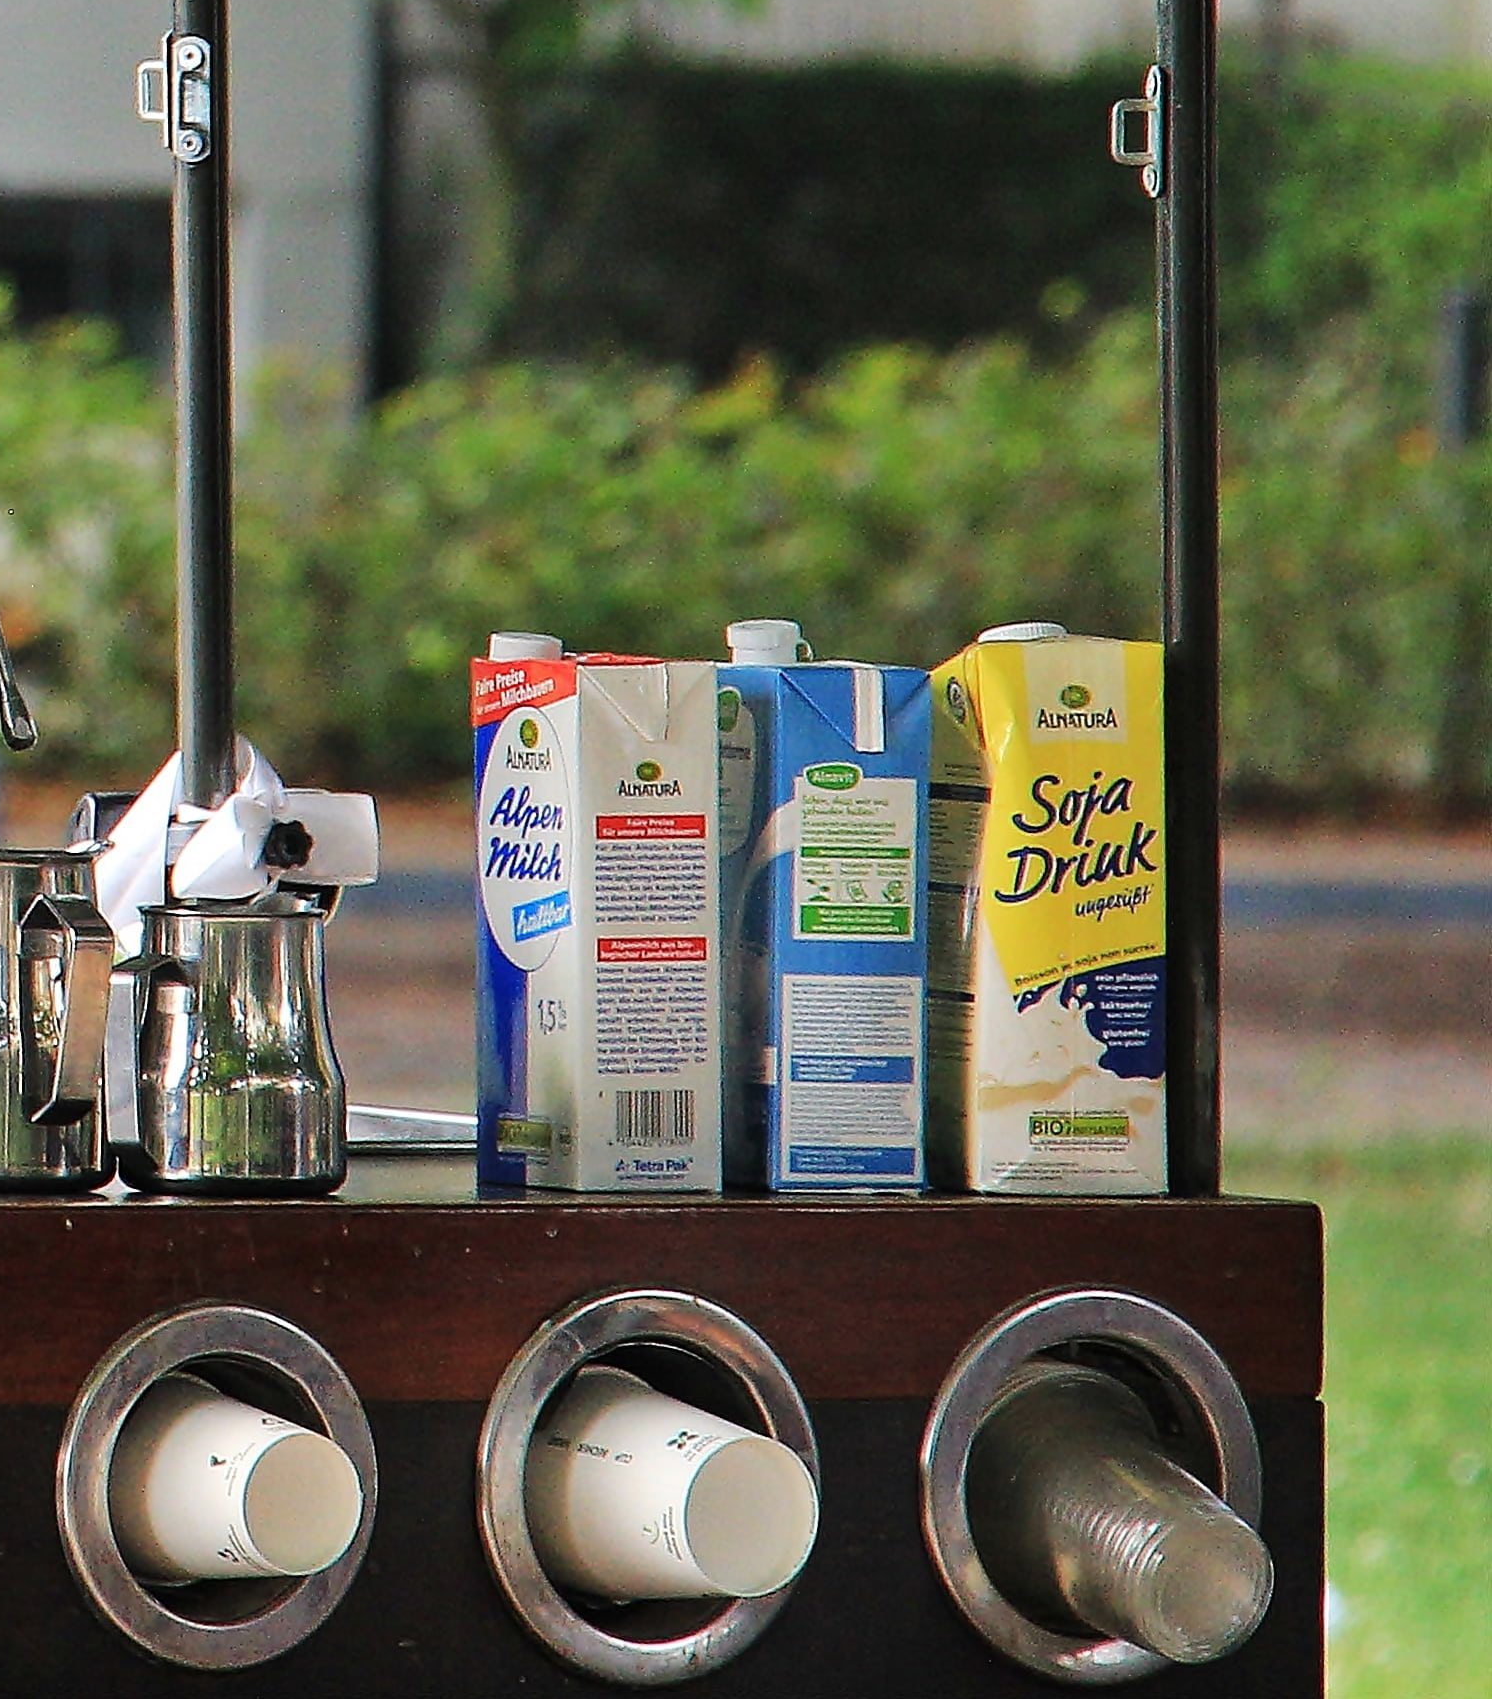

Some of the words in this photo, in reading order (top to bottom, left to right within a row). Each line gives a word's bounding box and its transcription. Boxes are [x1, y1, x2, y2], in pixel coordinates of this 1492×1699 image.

[495, 668, 526, 691] Preise
[1038, 708, 1117, 729] ALNATURA
[618, 779, 682, 797] ALNATURA
[489, 786, 563, 839] Alpen
[1012, 771, 1135, 847] Soja
[485, 836, 562, 882] Milch
[994, 821, 1158, 904] Drink
[632, 1159, 664, 1172] Tetra
